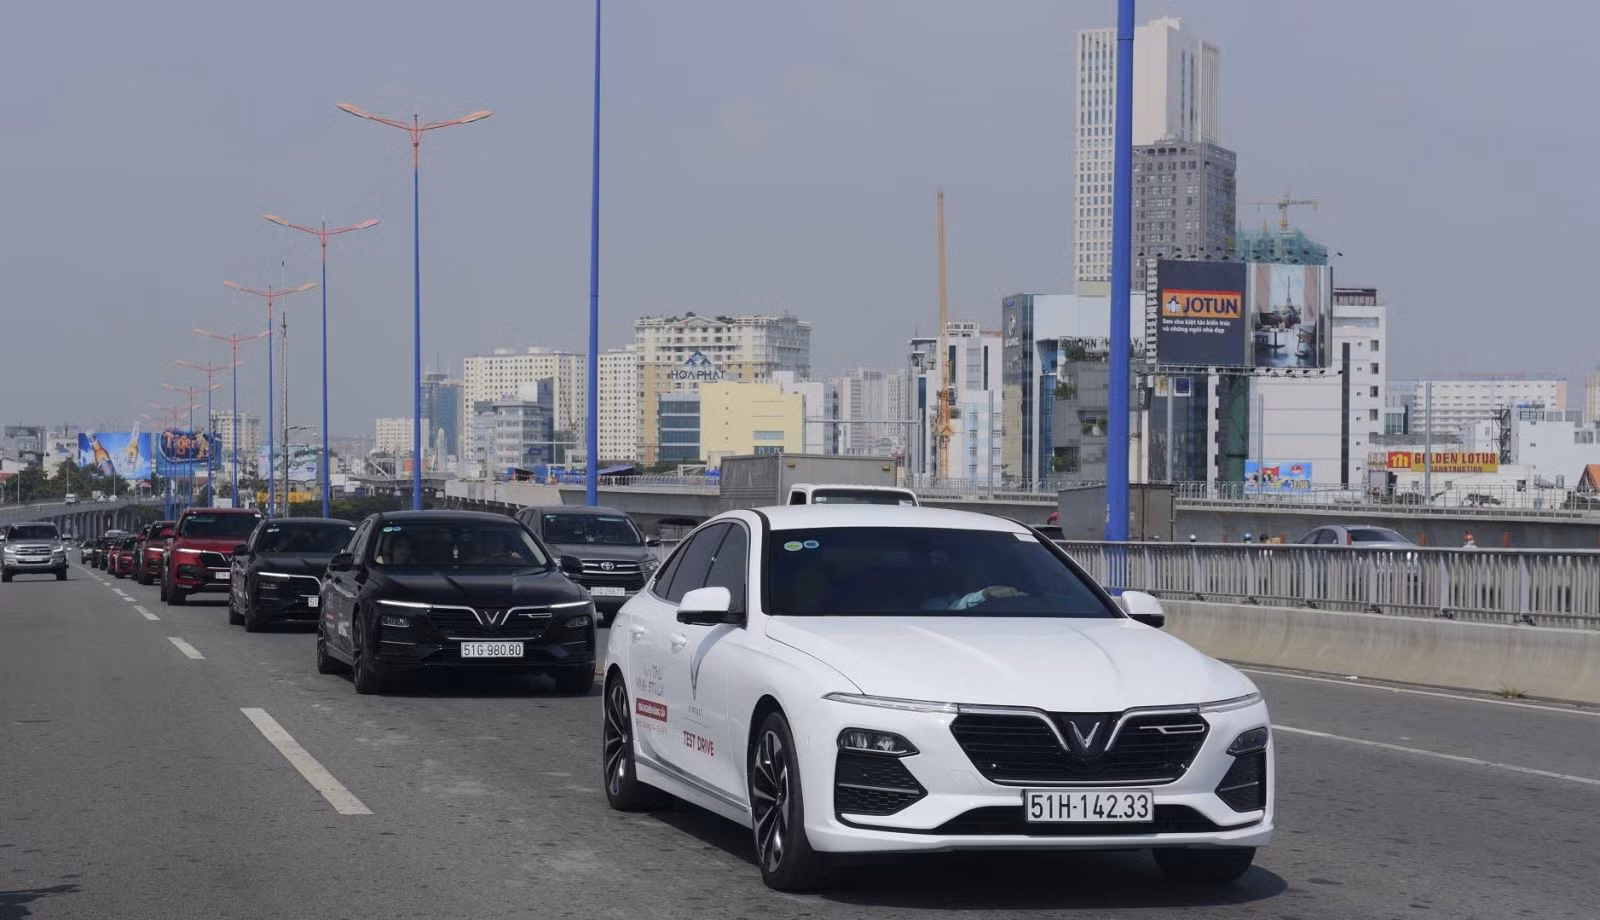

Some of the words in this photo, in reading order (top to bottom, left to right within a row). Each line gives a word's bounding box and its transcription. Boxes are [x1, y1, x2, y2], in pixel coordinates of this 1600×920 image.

[1183, 297, 1238, 314] JOTUN
[1462, 452, 1496, 465] LOTUS
[463, 644, 522, 656] 51G-980.80
[683, 730, 697, 750] TEST
[697, 734, 715, 757] DRIVE
[1031, 794, 1148, 819] 51H-142.33
